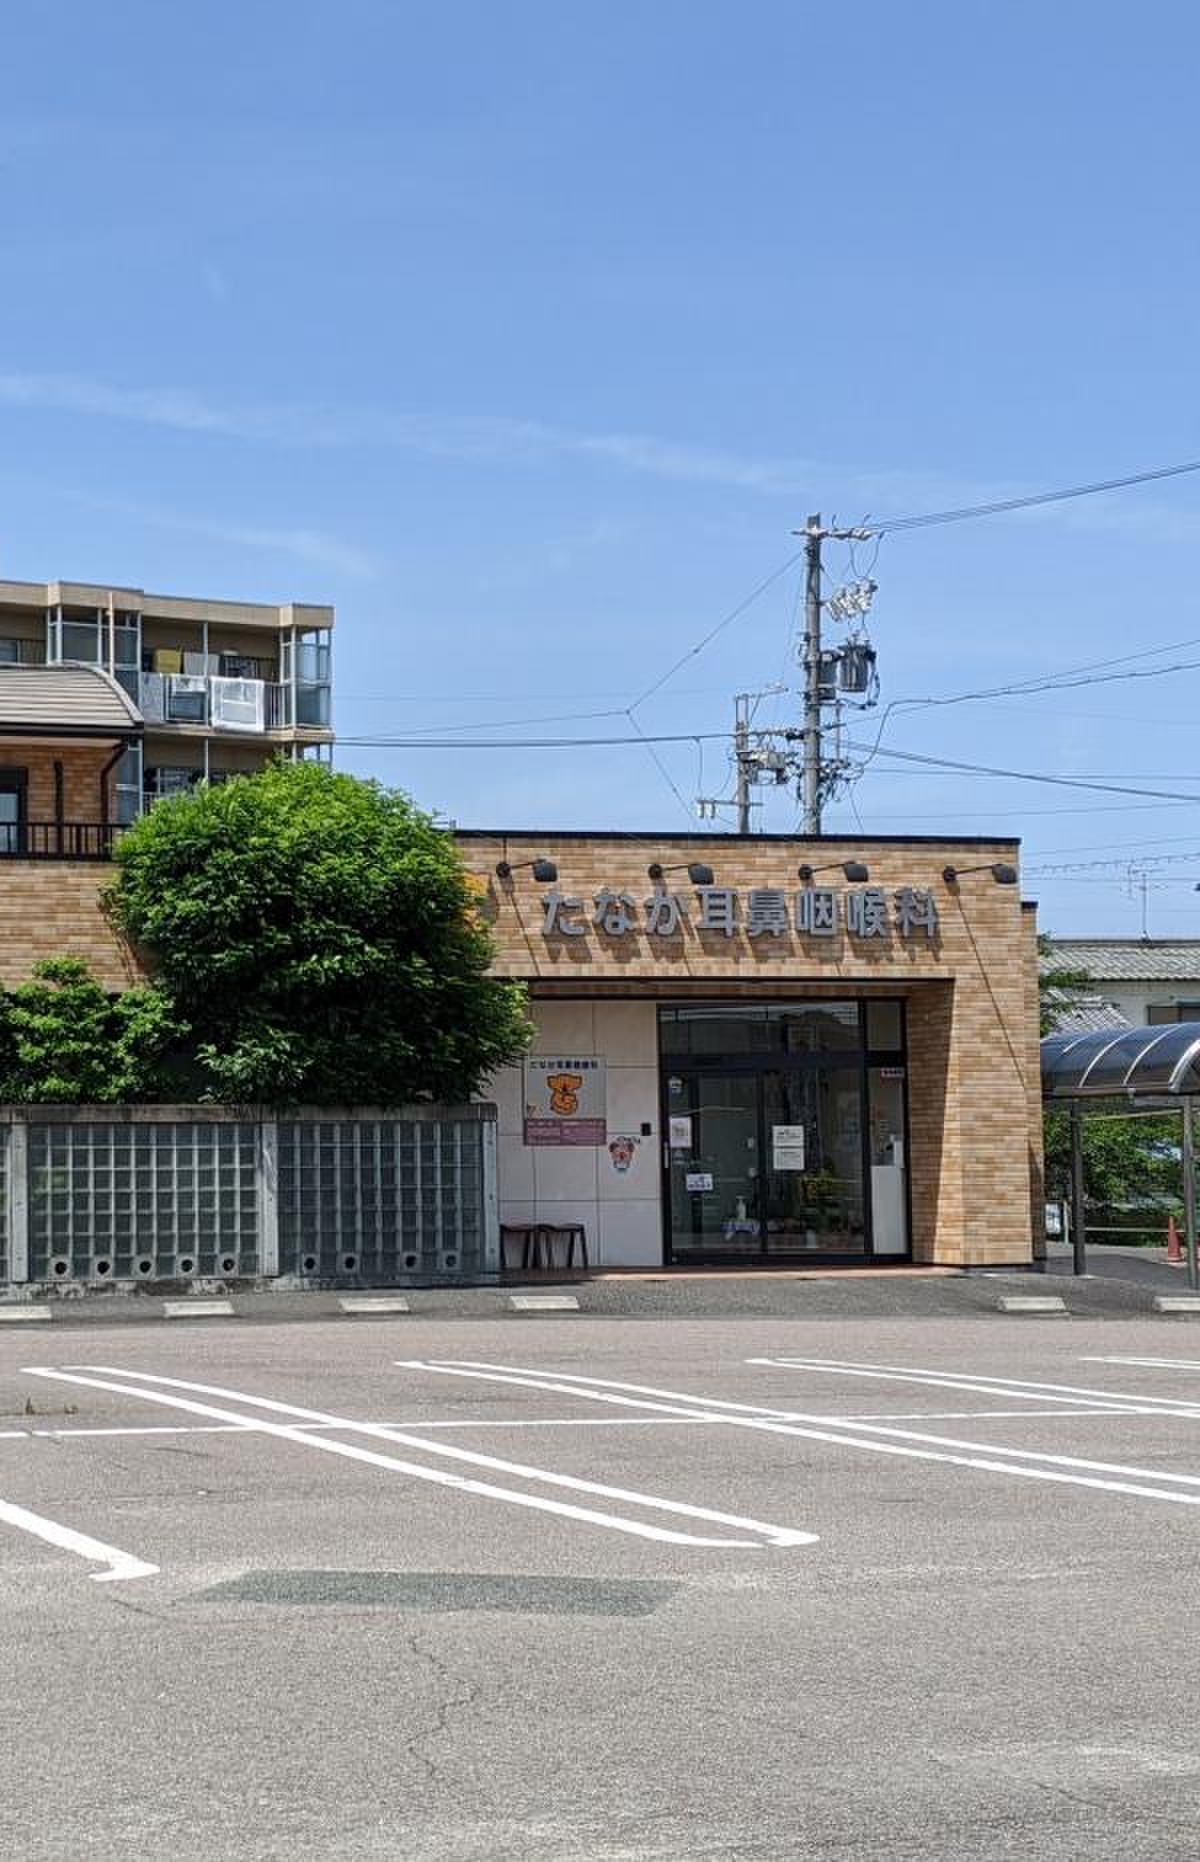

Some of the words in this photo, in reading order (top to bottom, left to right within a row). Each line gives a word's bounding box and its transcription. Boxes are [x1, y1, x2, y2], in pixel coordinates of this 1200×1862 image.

[542, 887, 937, 937] たなか耳鼻咽喉科
